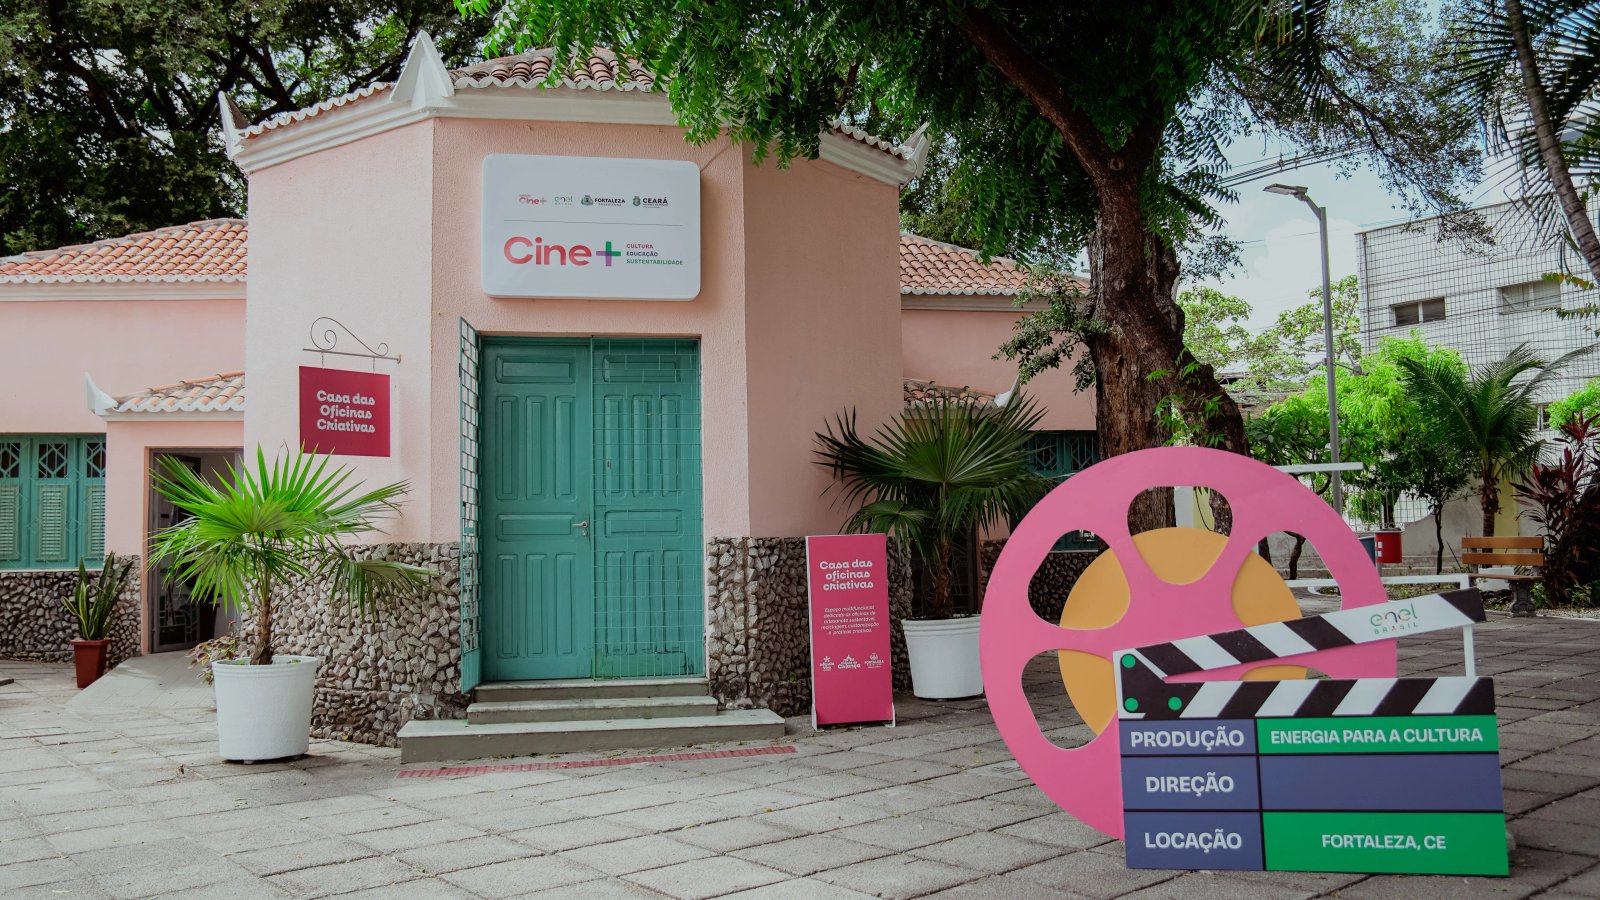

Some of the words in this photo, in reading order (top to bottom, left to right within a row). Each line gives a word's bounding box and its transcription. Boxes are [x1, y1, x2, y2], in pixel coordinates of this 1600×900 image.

[316, 389, 350, 404] Casa
[352, 393, 376, 406] das
[320, 404, 373, 420] Oficinas
[316, 418, 376, 433] Criativas
[819, 560, 850, 570] Casa
[851, 558, 873, 568] das
[825, 570, 871, 582] oficinas
[822, 580, 874, 591] criativas
[1370, 603, 1418, 627] enel
[1373, 621, 1419, 635] BRASIL
[1130, 726, 1245, 751] PRODUÇÃO
[1271, 730, 1340, 744] ENERGIA
[1343, 729, 1386, 743] PARA
[1388, 729, 1401, 742] A
[1403, 728, 1484, 742] CULTURA
[1145, 771, 1235, 797] DIREÇÃO
[1144, 828, 1243, 853] LOCAÇÃO
[1321, 834, 1421, 850] FORTALEZA,
[1423, 835, 1447, 849] CE
